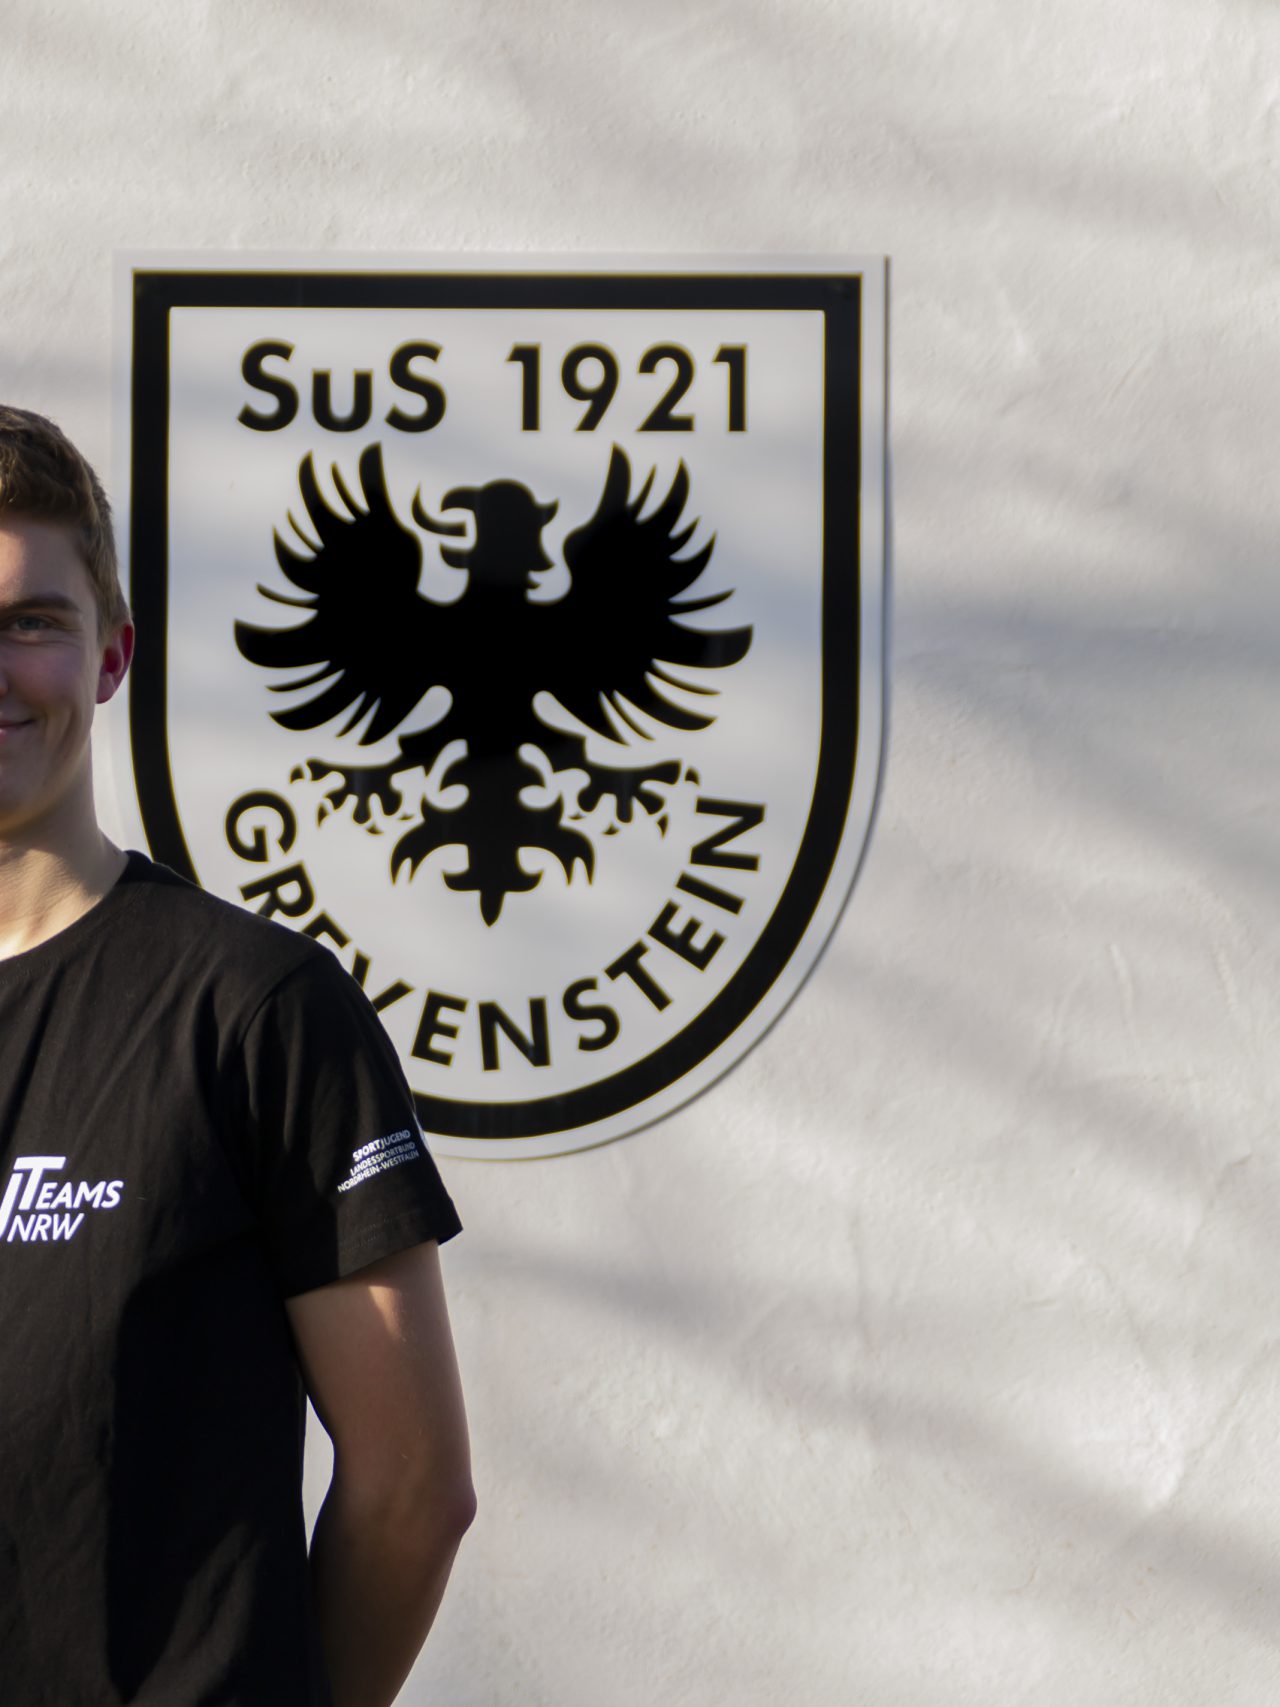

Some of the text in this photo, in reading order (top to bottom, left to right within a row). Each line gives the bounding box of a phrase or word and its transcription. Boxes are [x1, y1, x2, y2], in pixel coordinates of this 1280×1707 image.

[237, 337, 749, 433] SuS 1921
[6, 1212, 85, 1243] NRW
